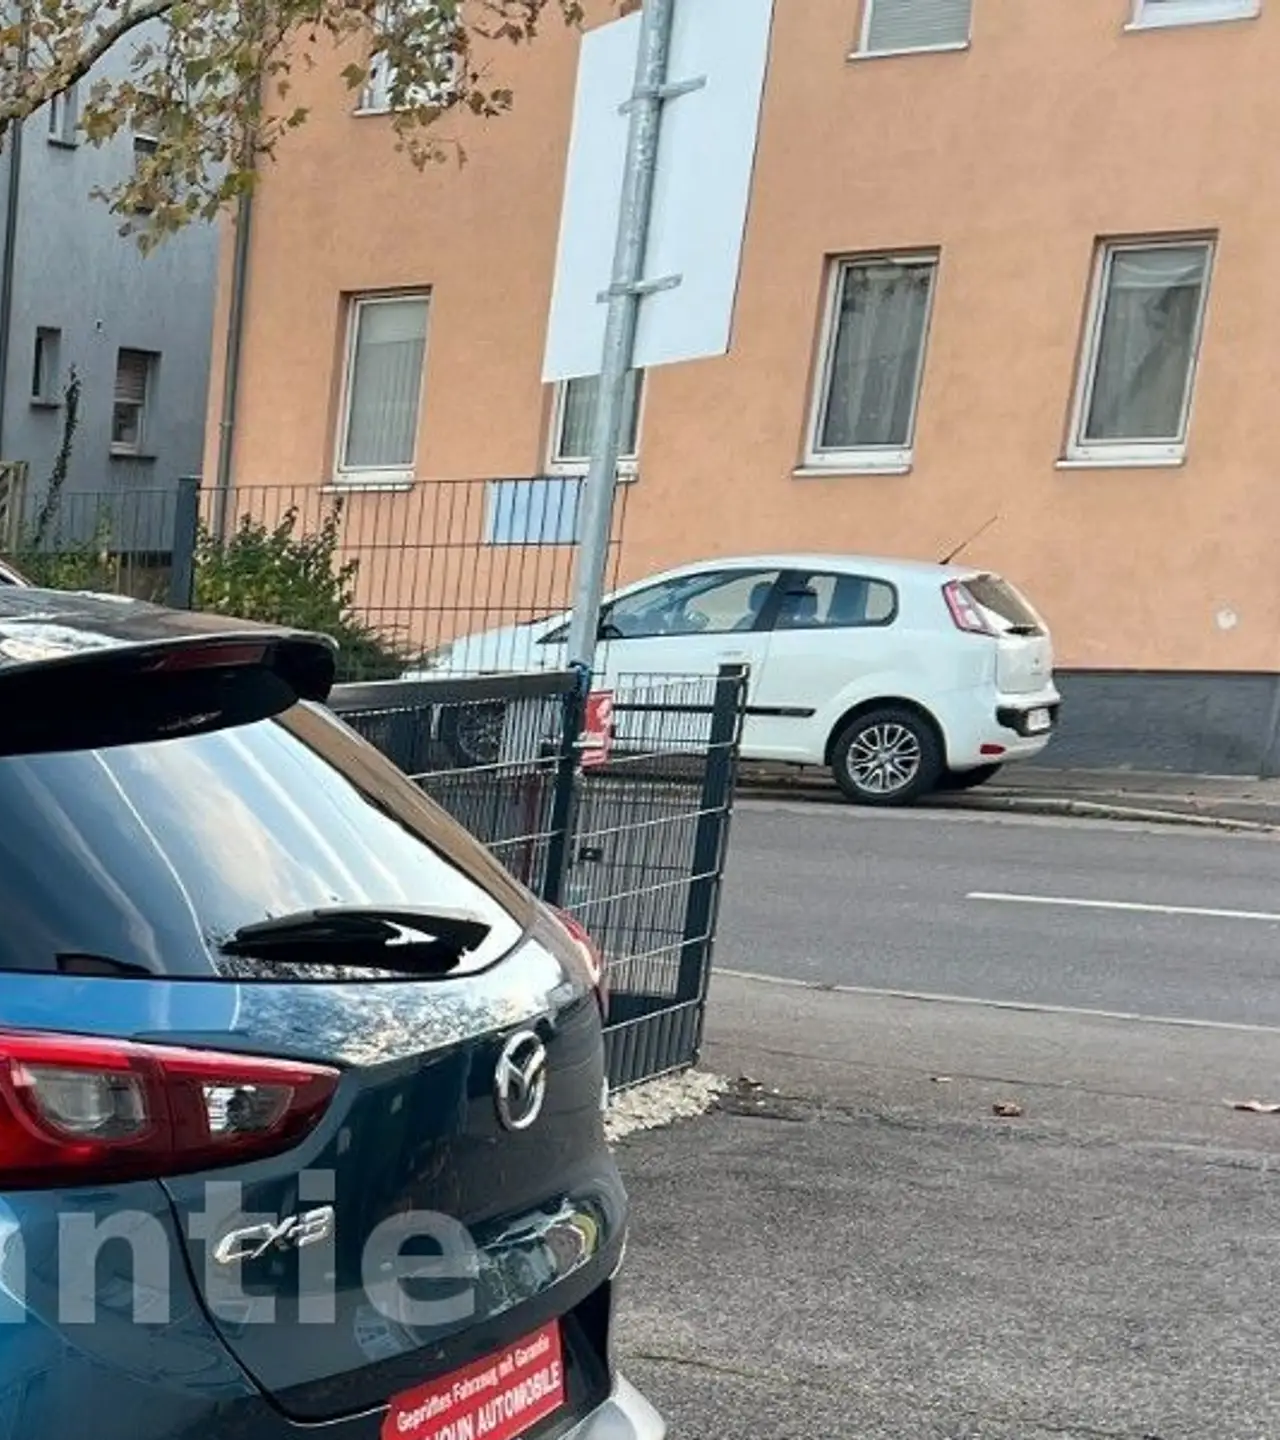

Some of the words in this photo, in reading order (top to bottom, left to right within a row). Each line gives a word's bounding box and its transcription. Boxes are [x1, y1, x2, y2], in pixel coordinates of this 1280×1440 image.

[214, 1205, 334, 1264] CX-3
[452, 1367, 498, 1402] Fahrzeug
[477, 1360, 561, 1438] AUTOMOBILE
